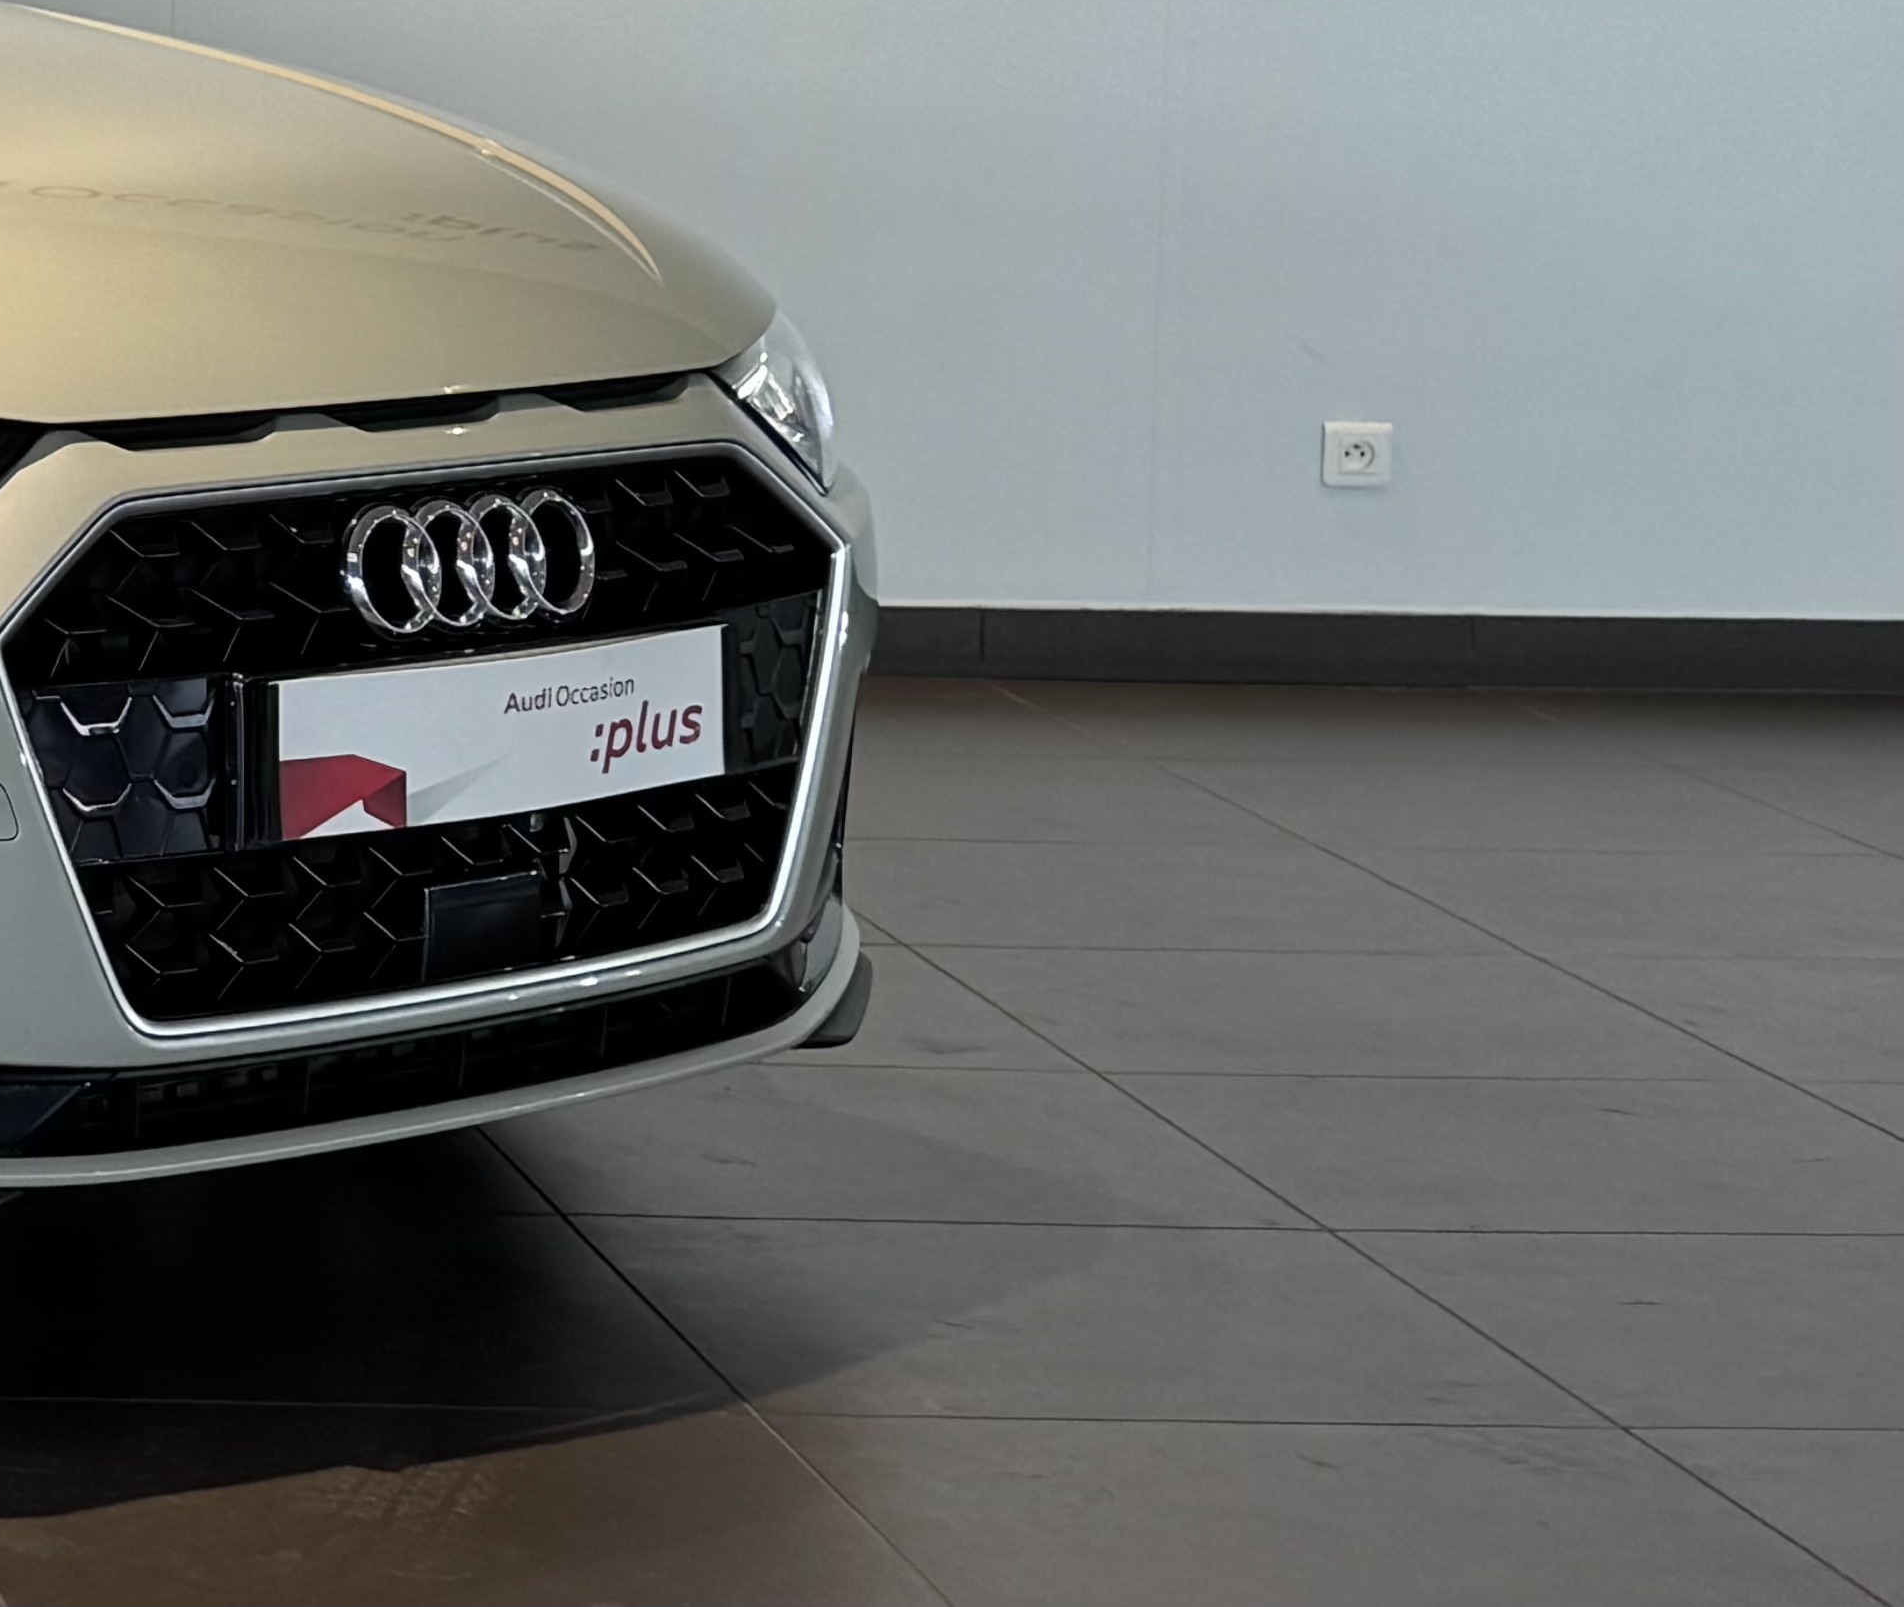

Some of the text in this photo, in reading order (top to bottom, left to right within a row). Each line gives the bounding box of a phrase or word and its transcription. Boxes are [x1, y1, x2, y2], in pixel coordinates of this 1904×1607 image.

[503, 676, 636, 715] Audi Occasion
[589, 699, 703, 775] :plus
